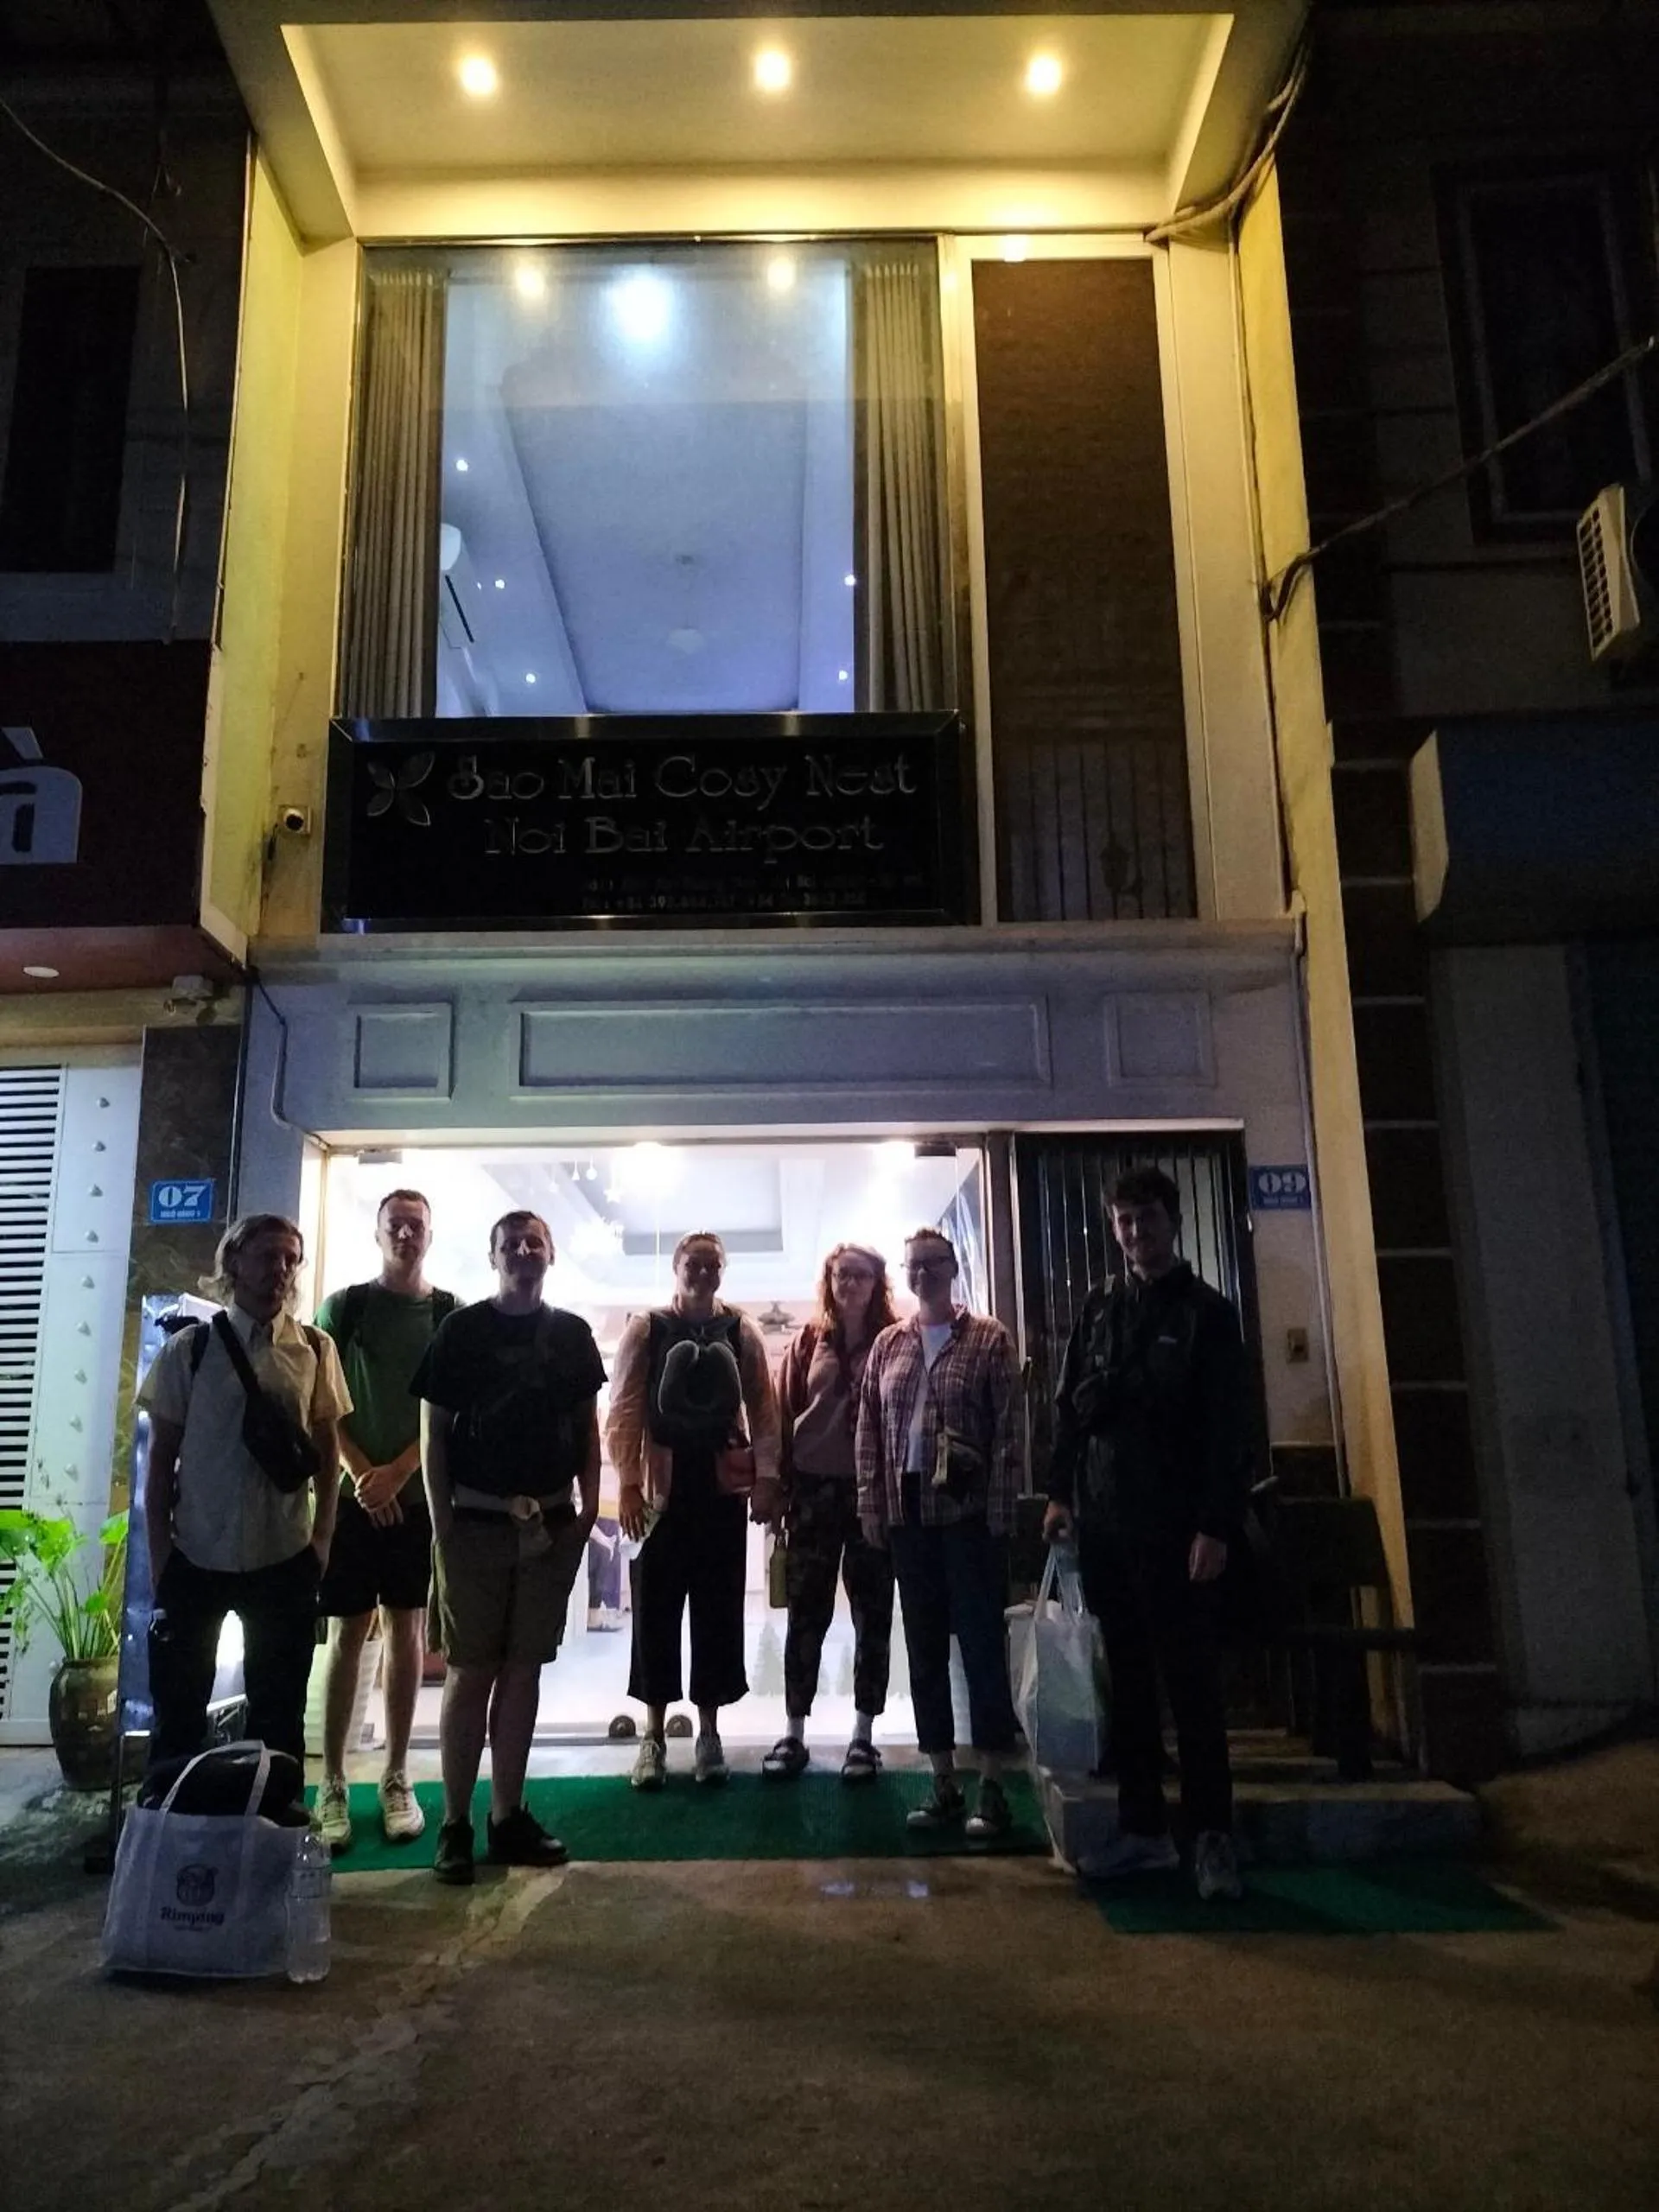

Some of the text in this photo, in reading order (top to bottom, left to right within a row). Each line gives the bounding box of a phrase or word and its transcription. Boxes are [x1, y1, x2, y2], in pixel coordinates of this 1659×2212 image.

[447, 752, 918, 812] Sao Mai Cosy Nest
[483, 813, 886, 865] Noi Bai Airport
[158, 1185, 207, 1208] 07
[1258, 1171, 1306, 1193] 09
